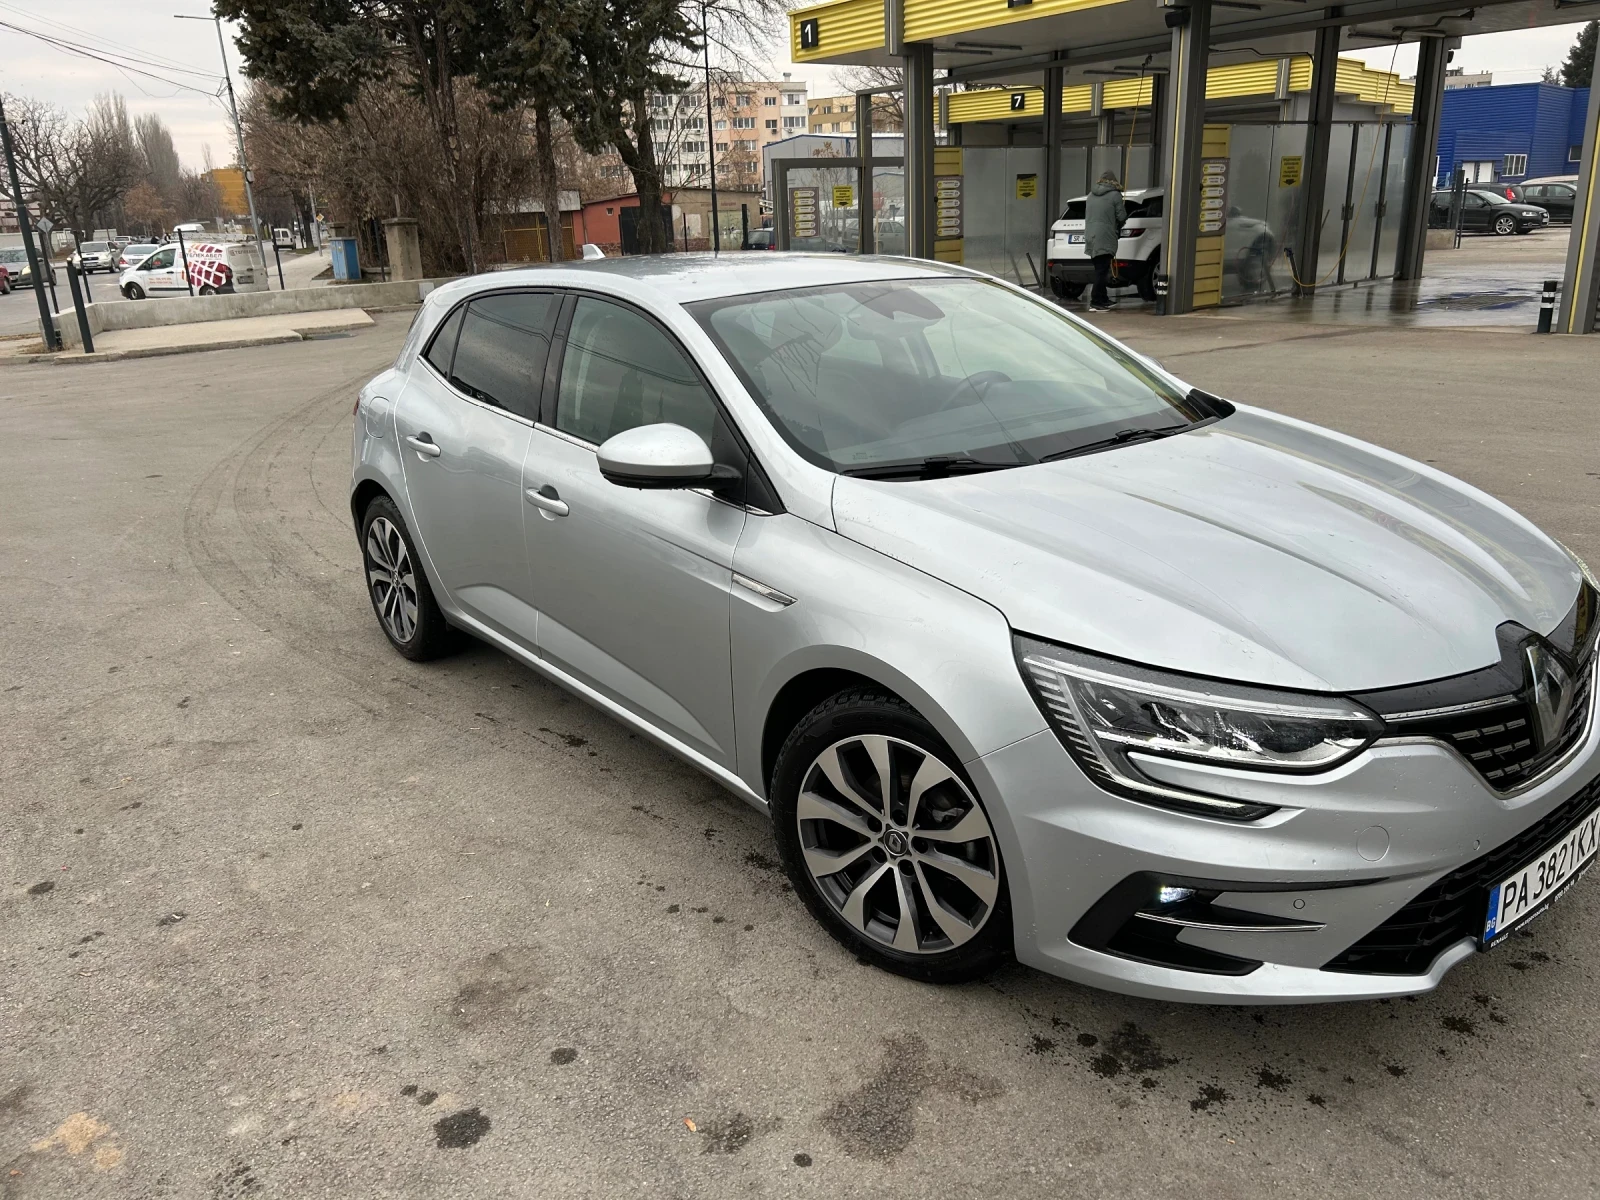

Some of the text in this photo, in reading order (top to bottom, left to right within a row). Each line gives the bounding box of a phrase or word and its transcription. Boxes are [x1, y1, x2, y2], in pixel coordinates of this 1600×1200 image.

[804, 23, 812, 43] 1
[1014, 96, 1022, 108] 7
[1501, 872, 1528, 924] PA
[1533, 834, 1576, 900] 3821
[1486, 917, 1496, 932] BG
